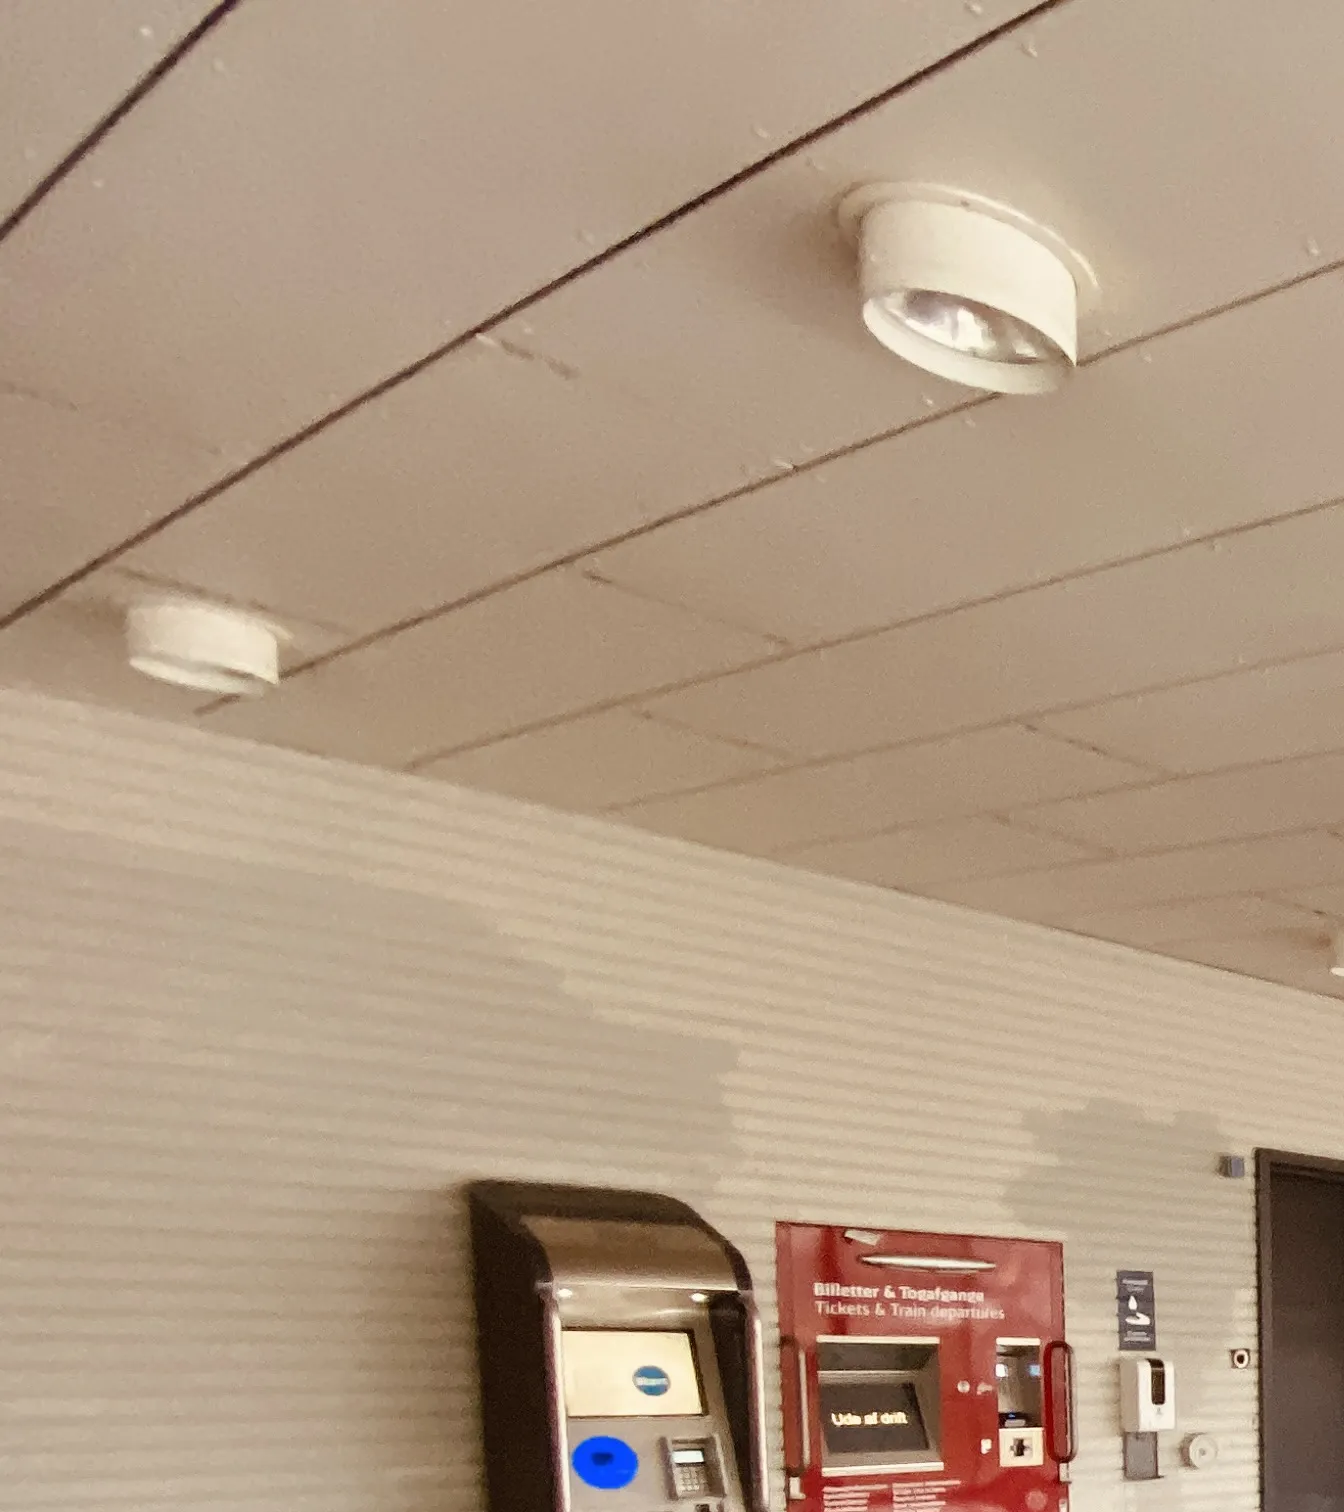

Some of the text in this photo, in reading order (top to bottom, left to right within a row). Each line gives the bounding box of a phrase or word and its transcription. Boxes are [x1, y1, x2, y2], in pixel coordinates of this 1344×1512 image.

[813, 1282, 879, 1298] Billetter
[883, 1285, 896, 1299] &
[815, 1301, 1005, 1320] Tickets & Train departures
